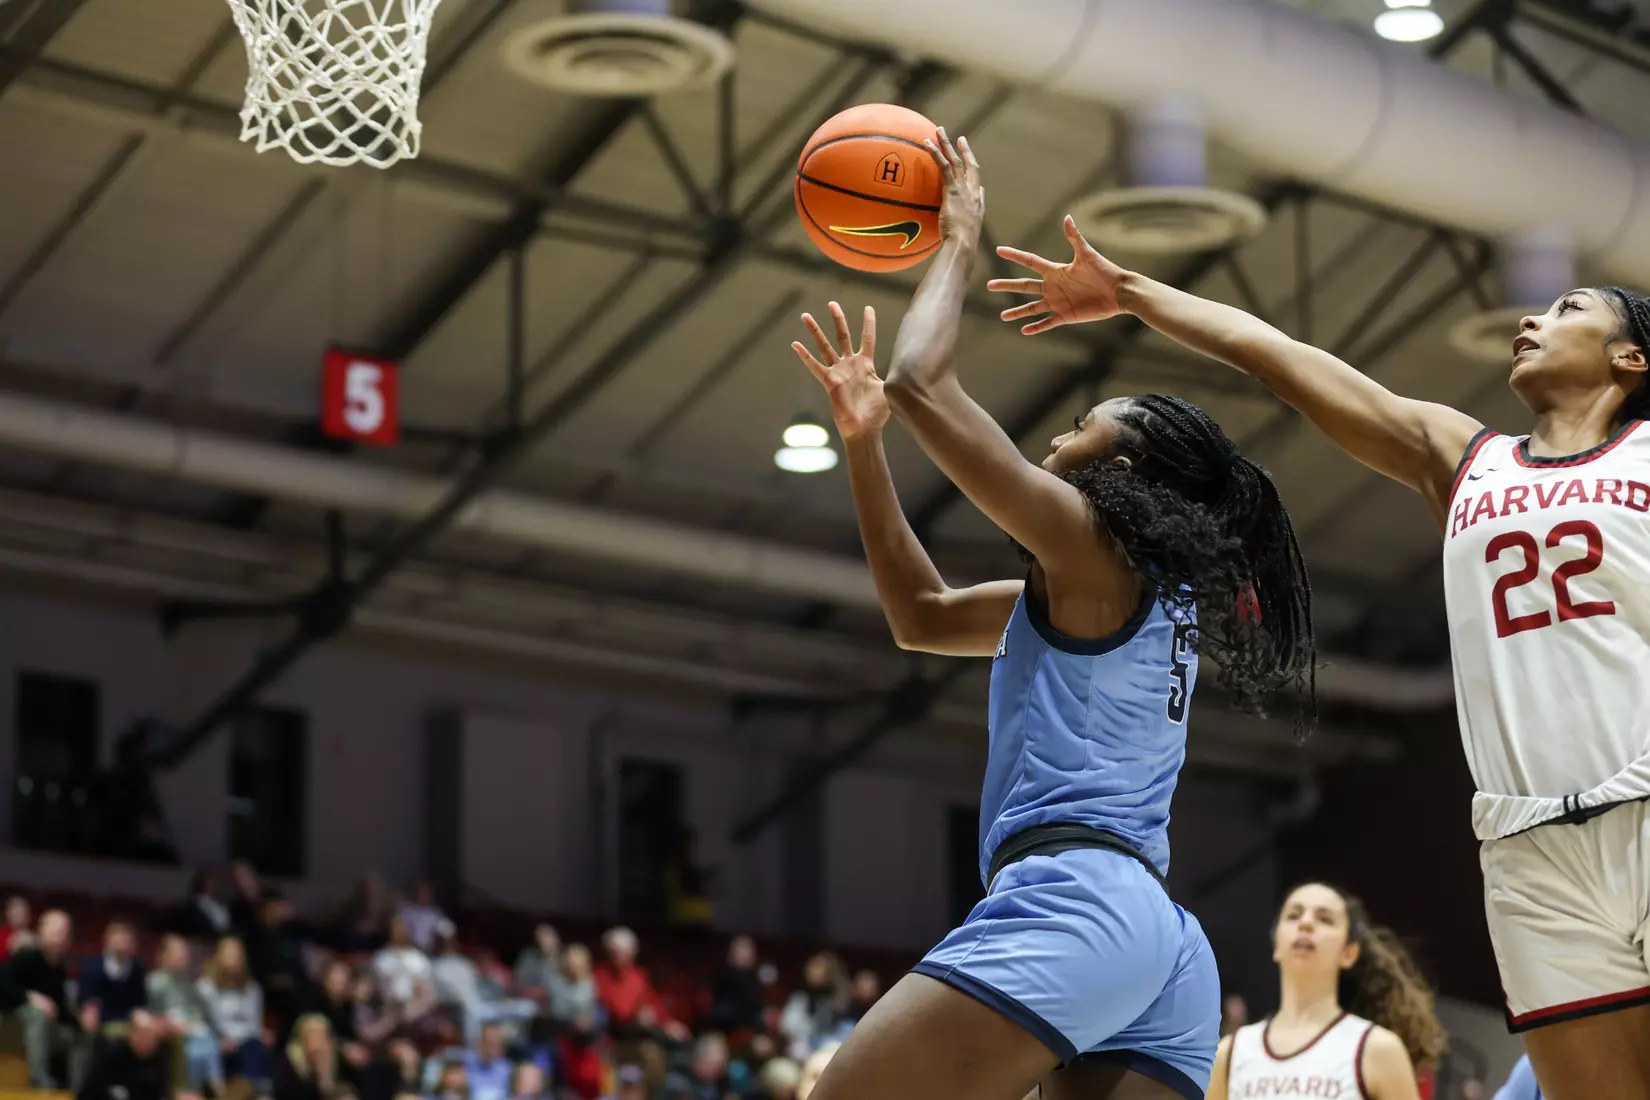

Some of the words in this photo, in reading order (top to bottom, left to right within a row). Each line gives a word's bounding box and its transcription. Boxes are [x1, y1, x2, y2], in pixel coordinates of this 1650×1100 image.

[881, 160, 899, 183] H
[343, 361, 386, 435] 5
[1451, 478, 1650, 539] HARVARD
[1485, 519, 1616, 638] 22
[1166, 621, 1190, 726] 5
